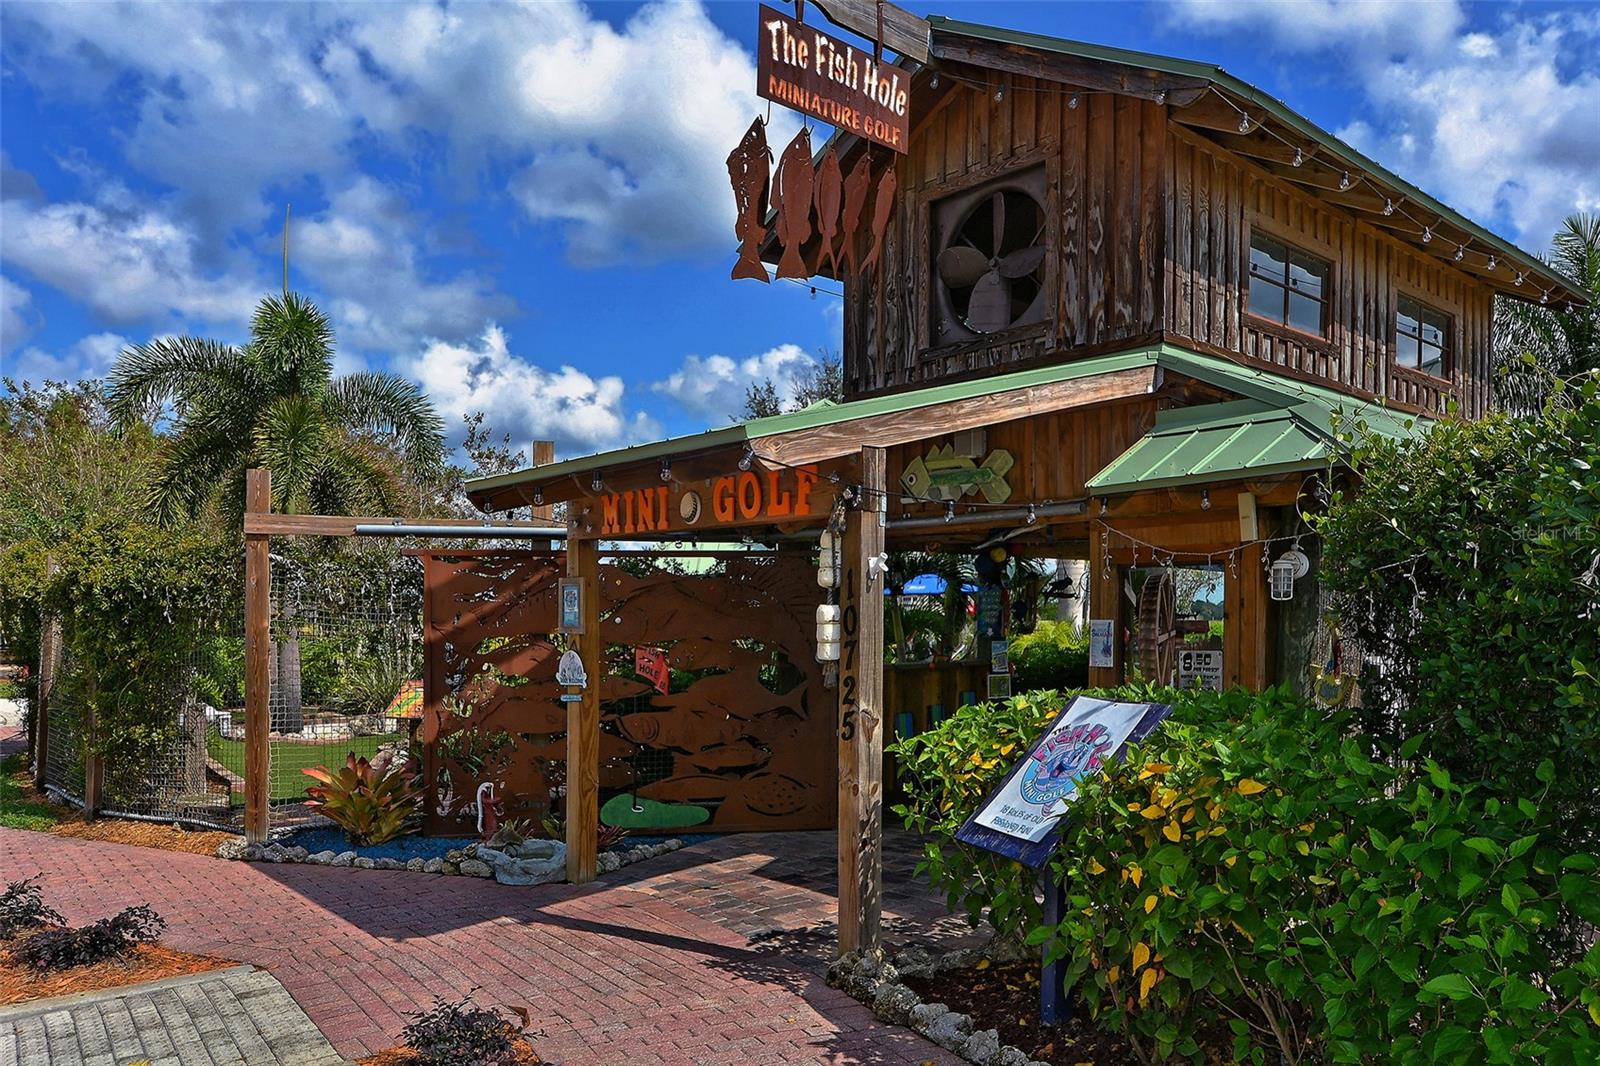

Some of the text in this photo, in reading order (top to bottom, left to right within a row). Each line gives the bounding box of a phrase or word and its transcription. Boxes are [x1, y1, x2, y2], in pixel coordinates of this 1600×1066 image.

[764, 20, 907, 117] The Fish Hole
[768, 73, 902, 146] MINIATURE GOLF
[600, 464, 821, 534] MINI GOLF
[639, 663, 659, 678] HOLE
[841, 568, 858, 741] 10725
[1052, 724, 1072, 736] THE
[1024, 780, 1065, 801] MINI GOLF
